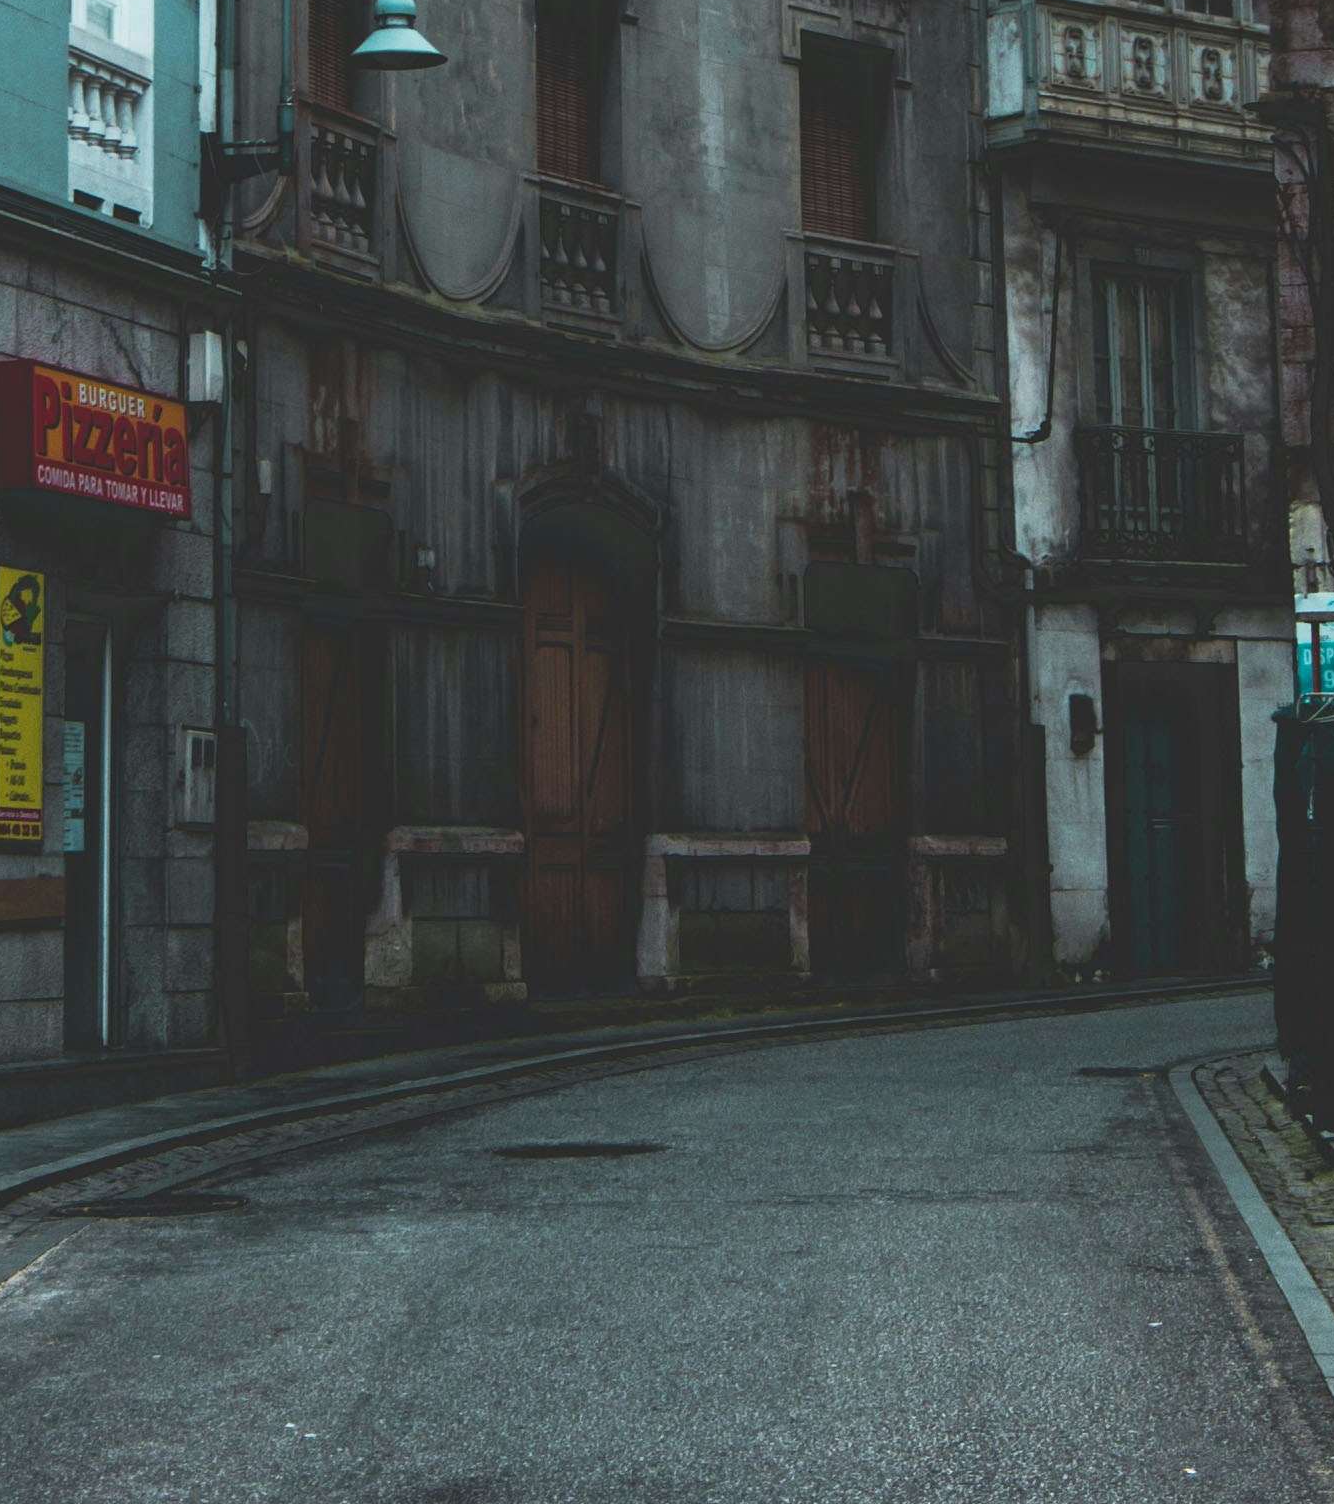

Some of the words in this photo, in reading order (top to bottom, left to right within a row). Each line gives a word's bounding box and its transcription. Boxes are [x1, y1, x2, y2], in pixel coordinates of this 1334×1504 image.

[79, 383, 145, 418] BURGUER
[34, 374, 187, 486] Pizzería
[37, 464, 76, 490] COMIDA
[78, 473, 104, 497] PARA
[105, 479, 138, 504] TOMAR
[141, 487, 147, 505] Y
[149, 489, 184, 511] LLEVAR
